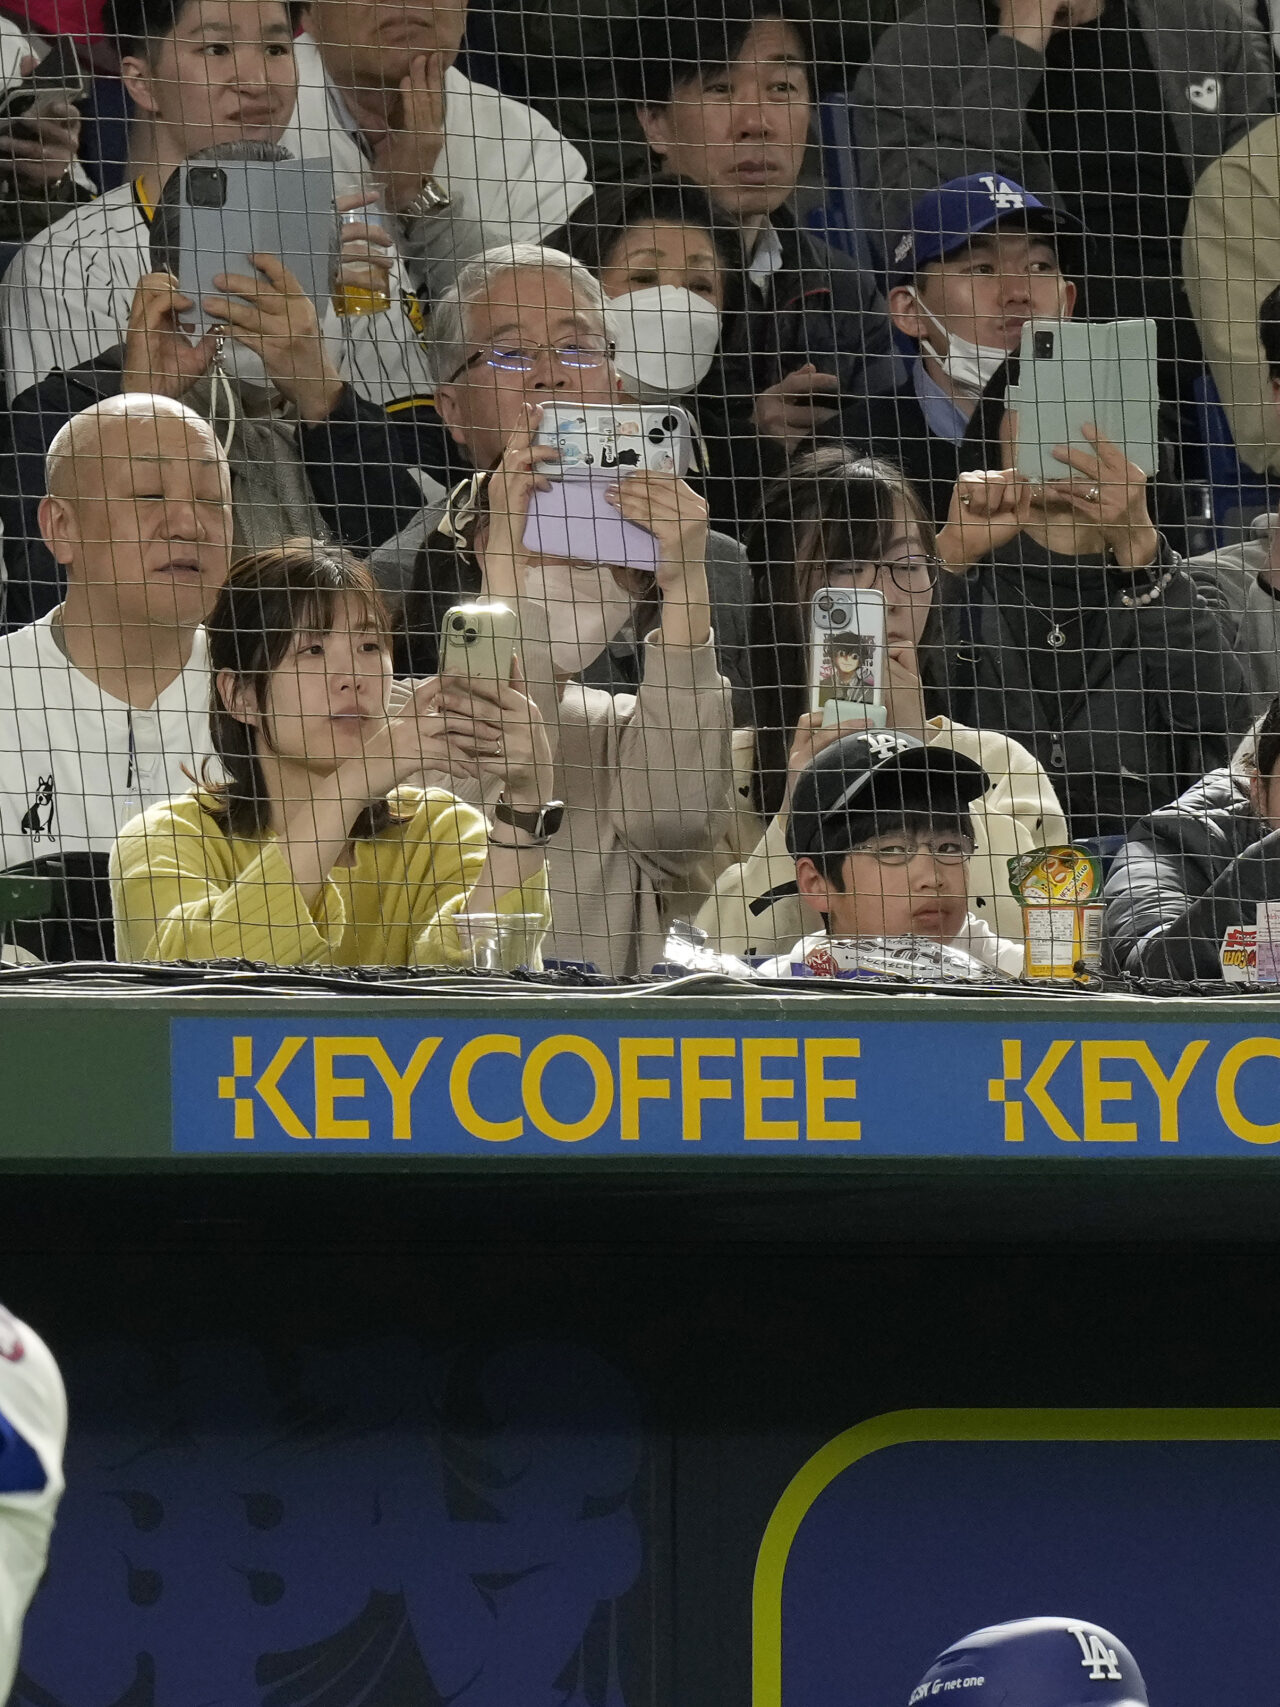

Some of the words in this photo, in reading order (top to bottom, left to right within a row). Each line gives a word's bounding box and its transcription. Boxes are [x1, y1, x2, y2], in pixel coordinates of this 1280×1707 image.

[978, 176, 1024, 208] LA
[1067, 1627, 1123, 1680] LA
[944, 1678, 963, 1691] net
[963, 1676, 986, 1688] one
